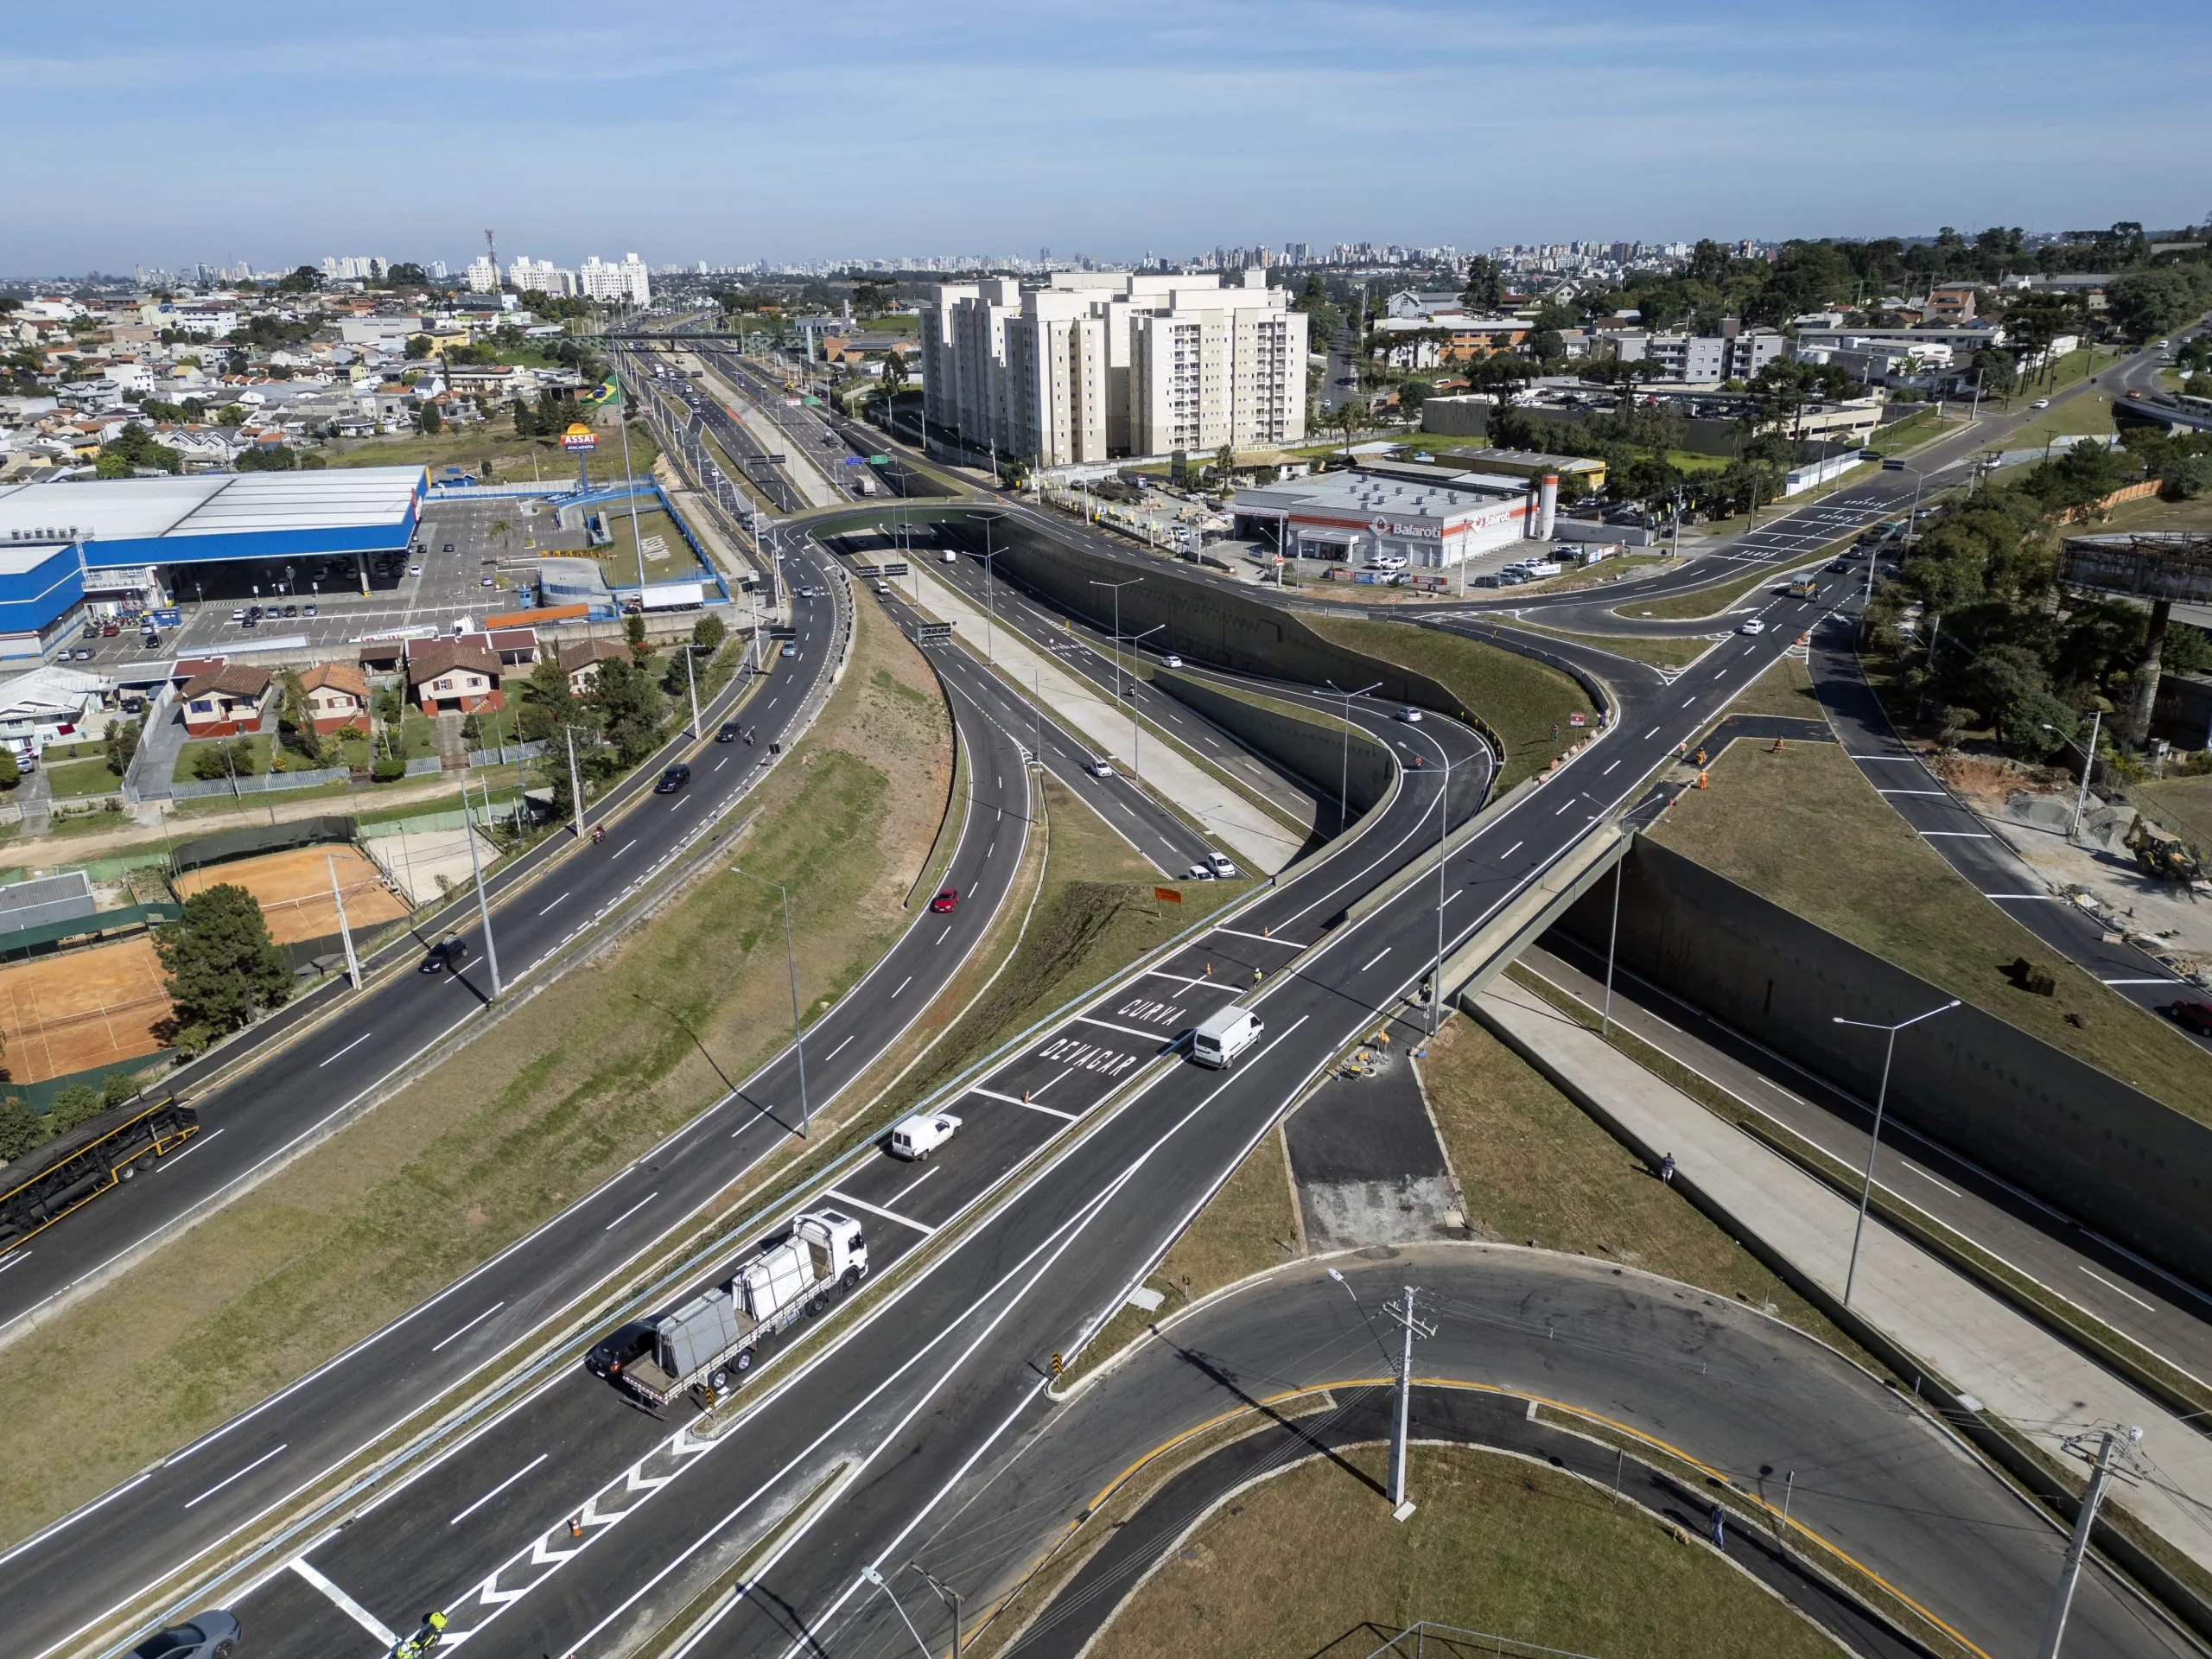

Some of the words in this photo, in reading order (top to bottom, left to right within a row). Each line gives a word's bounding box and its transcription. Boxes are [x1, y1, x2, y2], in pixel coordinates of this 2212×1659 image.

[1484, 511, 1510, 526] Balaroti
[1393, 523, 1441, 538] Balaroti
[1117, 999, 1187, 1026] CURVA
[1039, 1038, 1137, 1077] DEVAGAR
